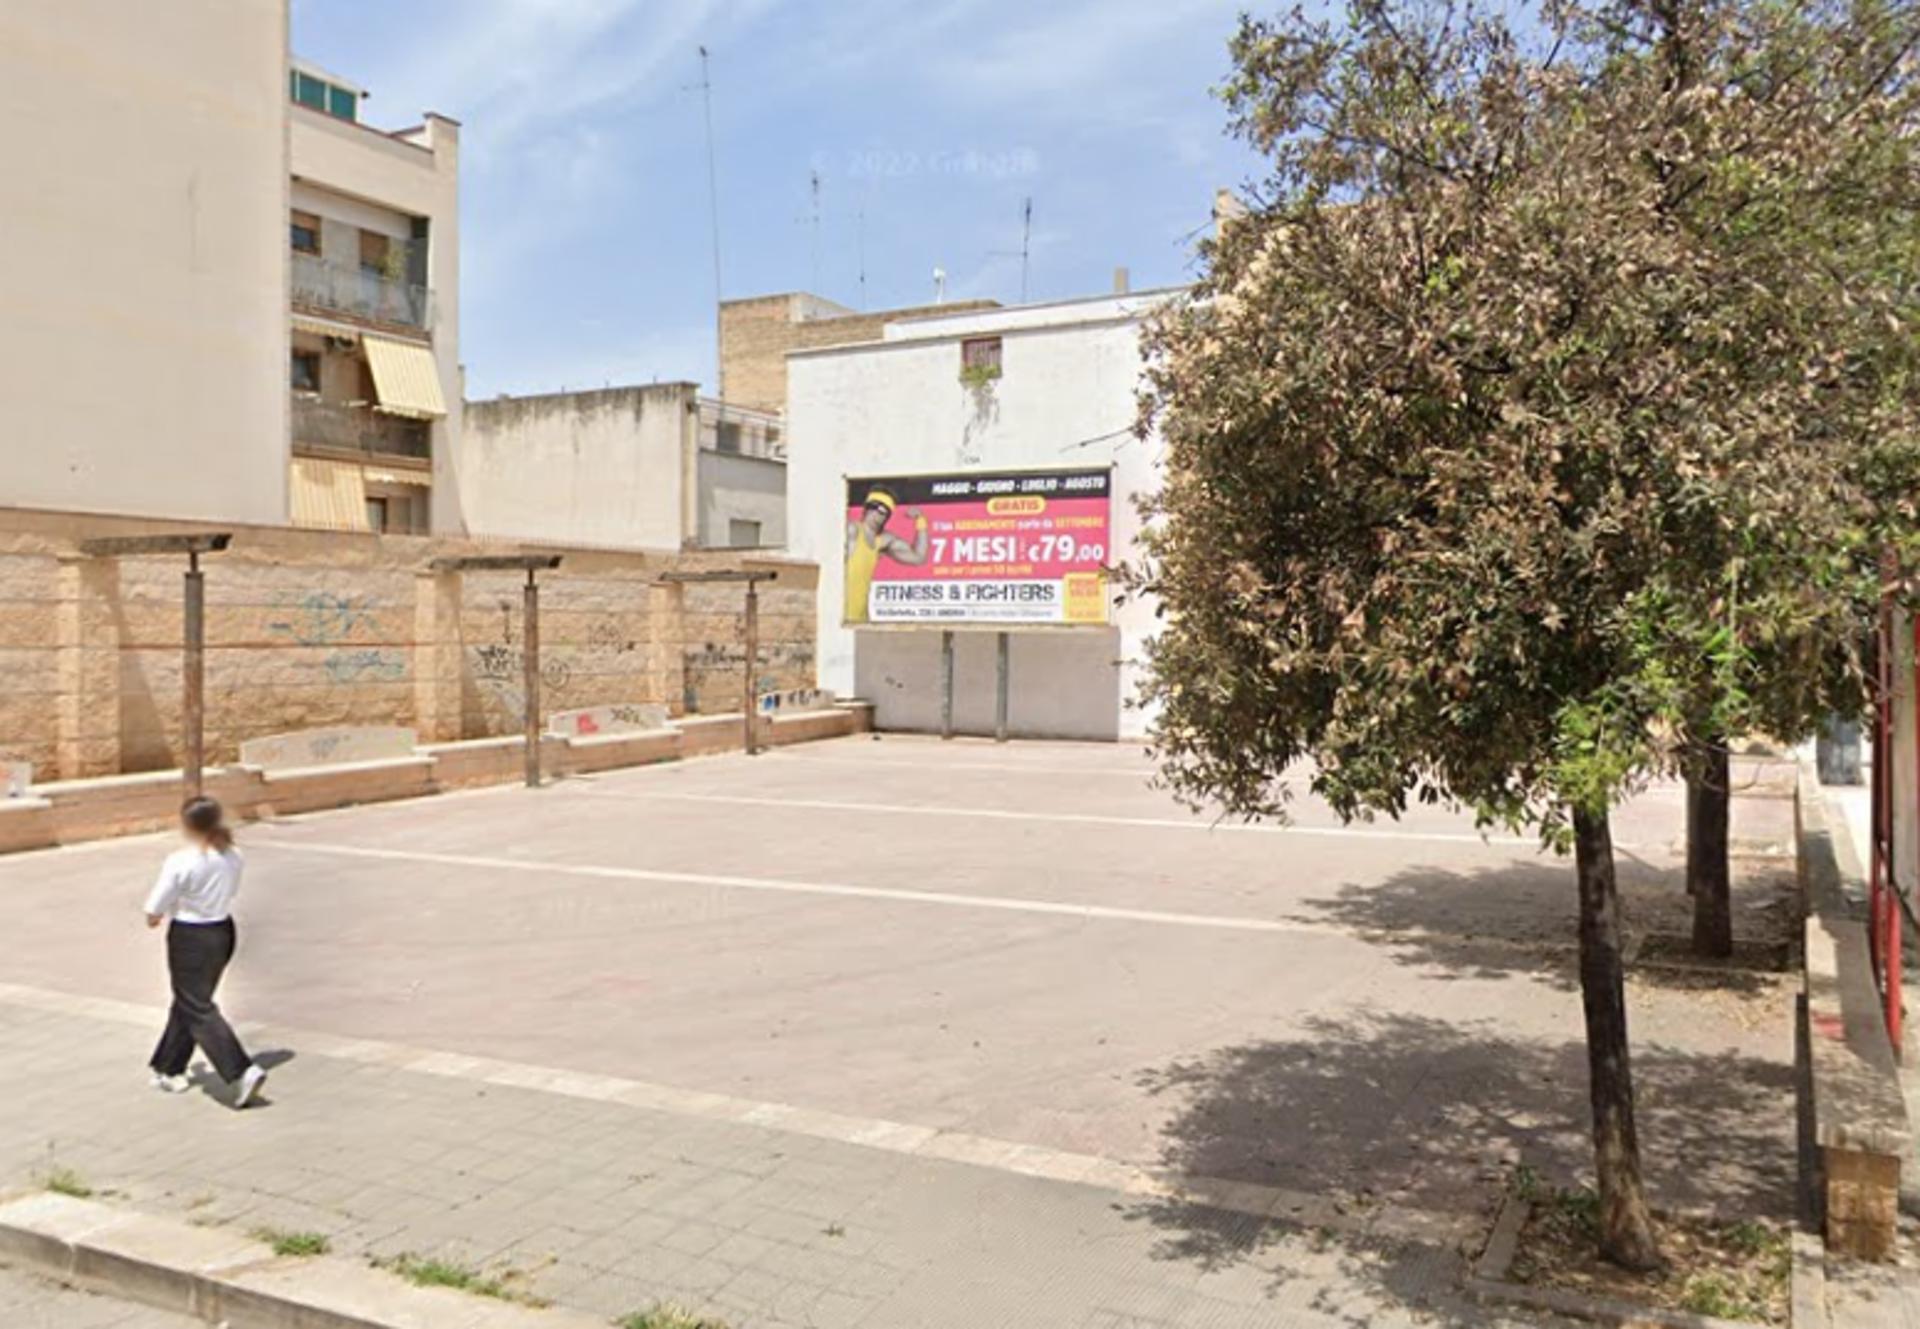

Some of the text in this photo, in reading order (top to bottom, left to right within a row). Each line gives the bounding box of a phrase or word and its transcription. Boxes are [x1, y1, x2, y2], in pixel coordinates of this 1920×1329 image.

[932, 482, 970, 494] MAGGIO
[1064, 476, 1106, 490] AGOSTO
[992, 498, 1039, 511] GRATIS
[931, 538, 946, 563] 7
[953, 536, 1016, 563] MESI
[875, 586, 943, 600] FITNESS
[949, 585, 960, 600] &
[965, 584, 1055, 600] FIGHTERS
